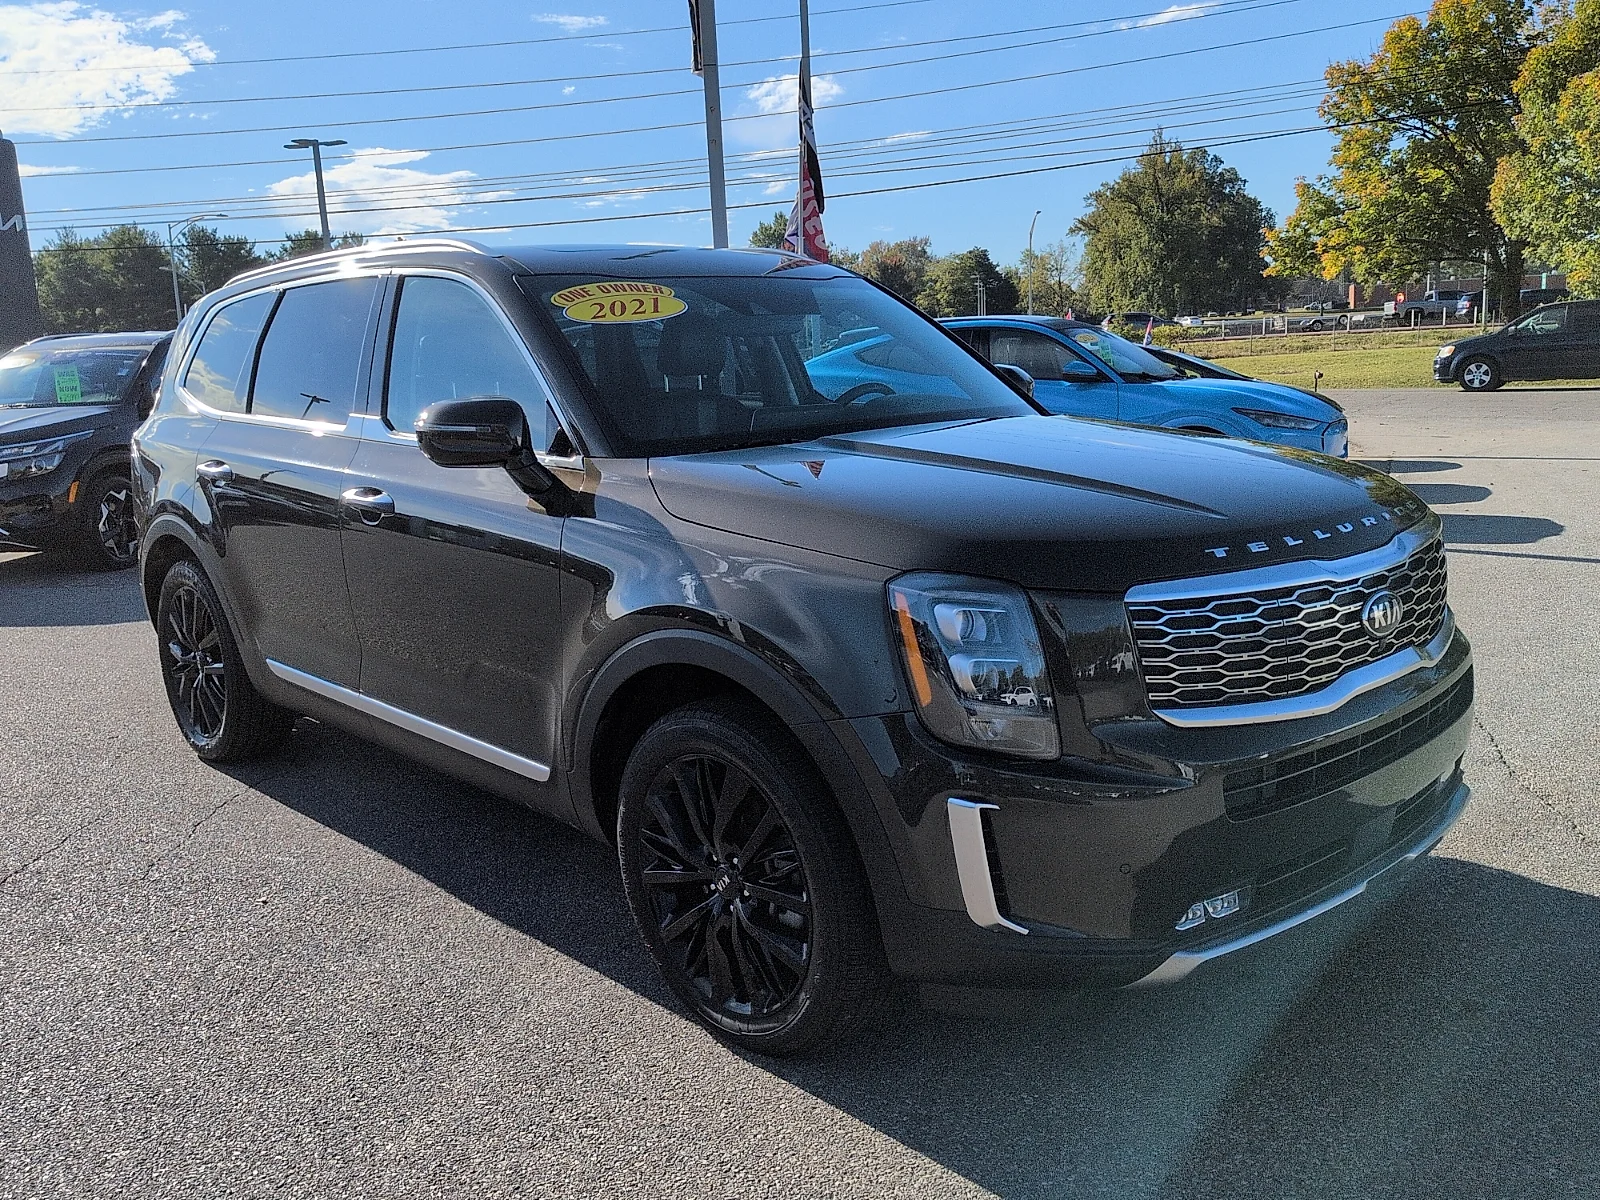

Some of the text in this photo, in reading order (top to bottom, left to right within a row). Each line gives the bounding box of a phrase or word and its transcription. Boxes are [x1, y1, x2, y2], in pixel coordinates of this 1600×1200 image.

[559, 283, 665, 303] ONE OWNER
[589, 297, 662, 320] 2021
[59, 385, 78, 393] NOW
[1205, 500, 1418, 558] TELLURIDE
[1371, 599, 1401, 629] KIA
[716, 874, 730, 892] KIA
